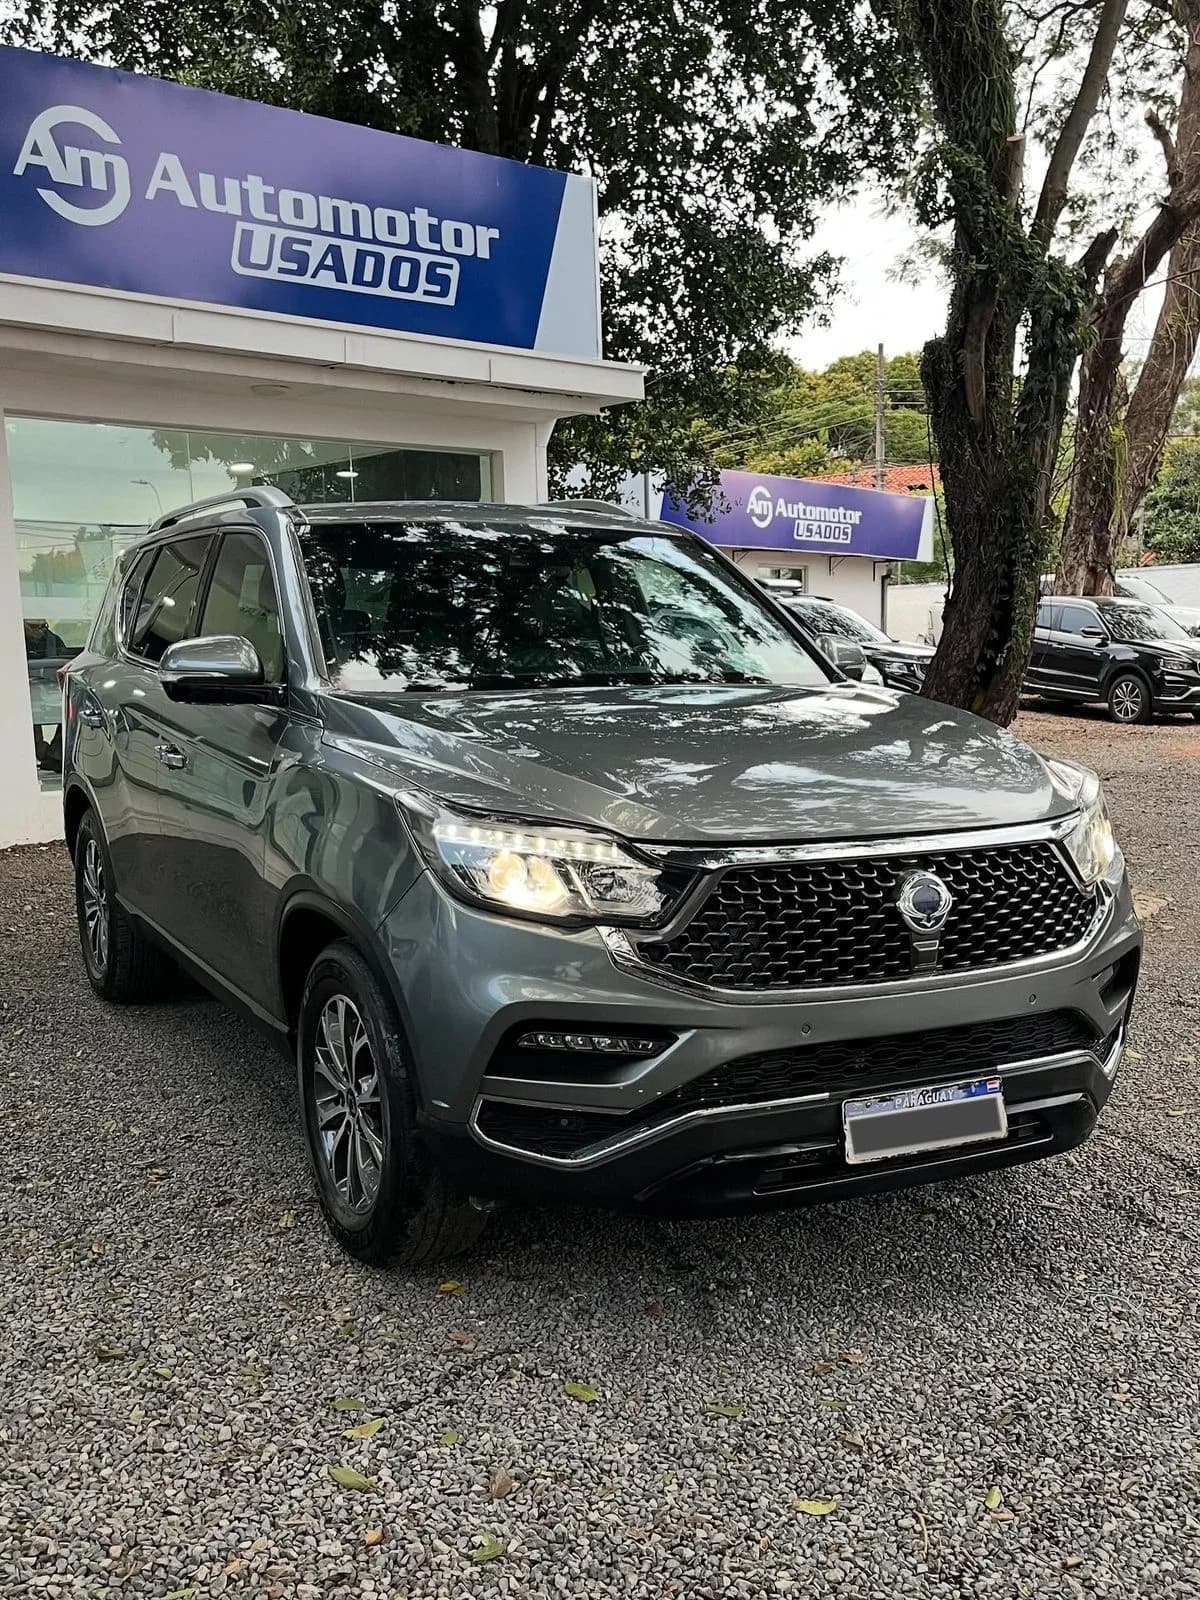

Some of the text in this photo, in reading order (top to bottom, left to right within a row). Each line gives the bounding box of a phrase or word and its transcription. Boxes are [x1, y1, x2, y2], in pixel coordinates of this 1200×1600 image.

[145, 153, 499, 259] Automotor
[239, 228, 453, 299] USADOS
[775, 498, 862, 524] Automotor
[796, 522, 850, 541] USADOS
[895, 1089, 954, 1109] PARAGUAY
